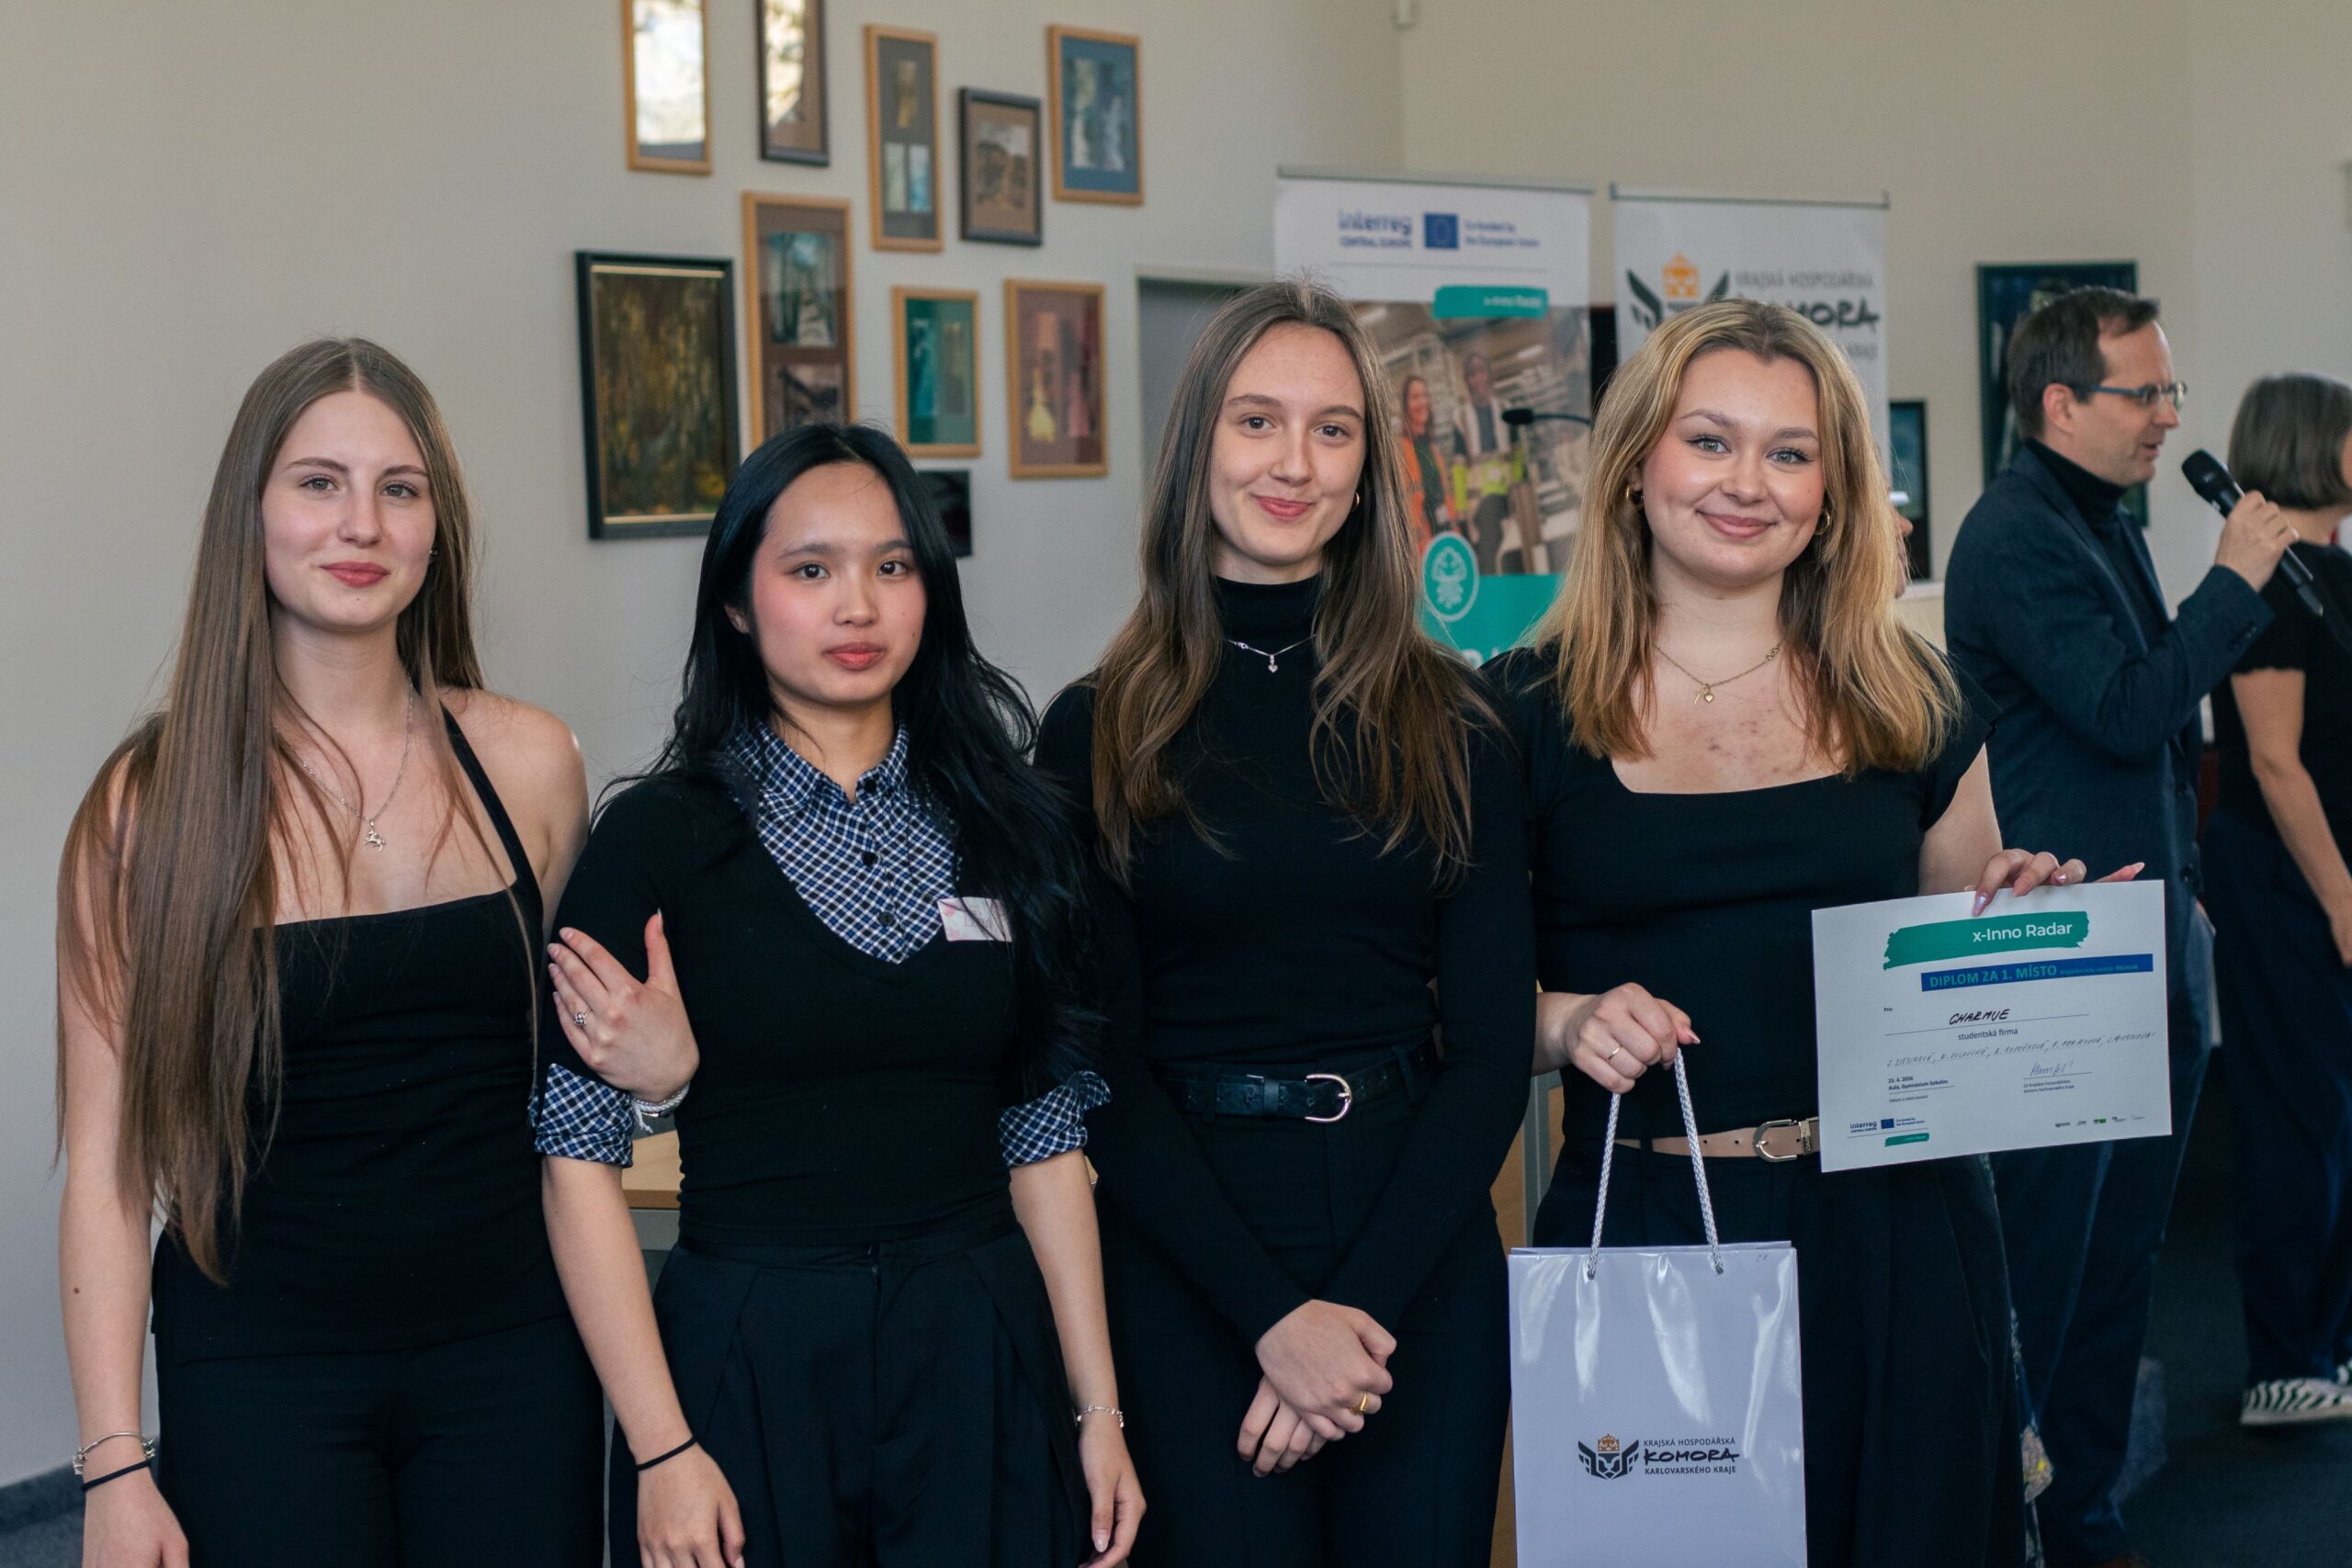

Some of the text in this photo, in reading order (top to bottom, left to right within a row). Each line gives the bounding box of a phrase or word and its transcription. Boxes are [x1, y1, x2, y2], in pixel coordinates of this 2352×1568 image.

[1972, 922, 2073, 942] x-Inno Radar
[1929, 974, 1979, 987] DIPLOM
[1983, 972, 1998, 983] ZA
[2001, 969, 2013, 980] 1.
[2016, 964, 2057, 979] MÍSTO
[1949, 1009, 2010, 1025] CHARMUE
[1958, 1028, 2018, 1041] studentská firma
[1644, 1437, 1736, 1448] KRAJSKÁ HOSPODÁŘSKÁ
[1644, 1448, 1740, 1465] KOMORA
[1645, 1465, 1736, 1475] KARLOVARSKÉHO KRAJE
